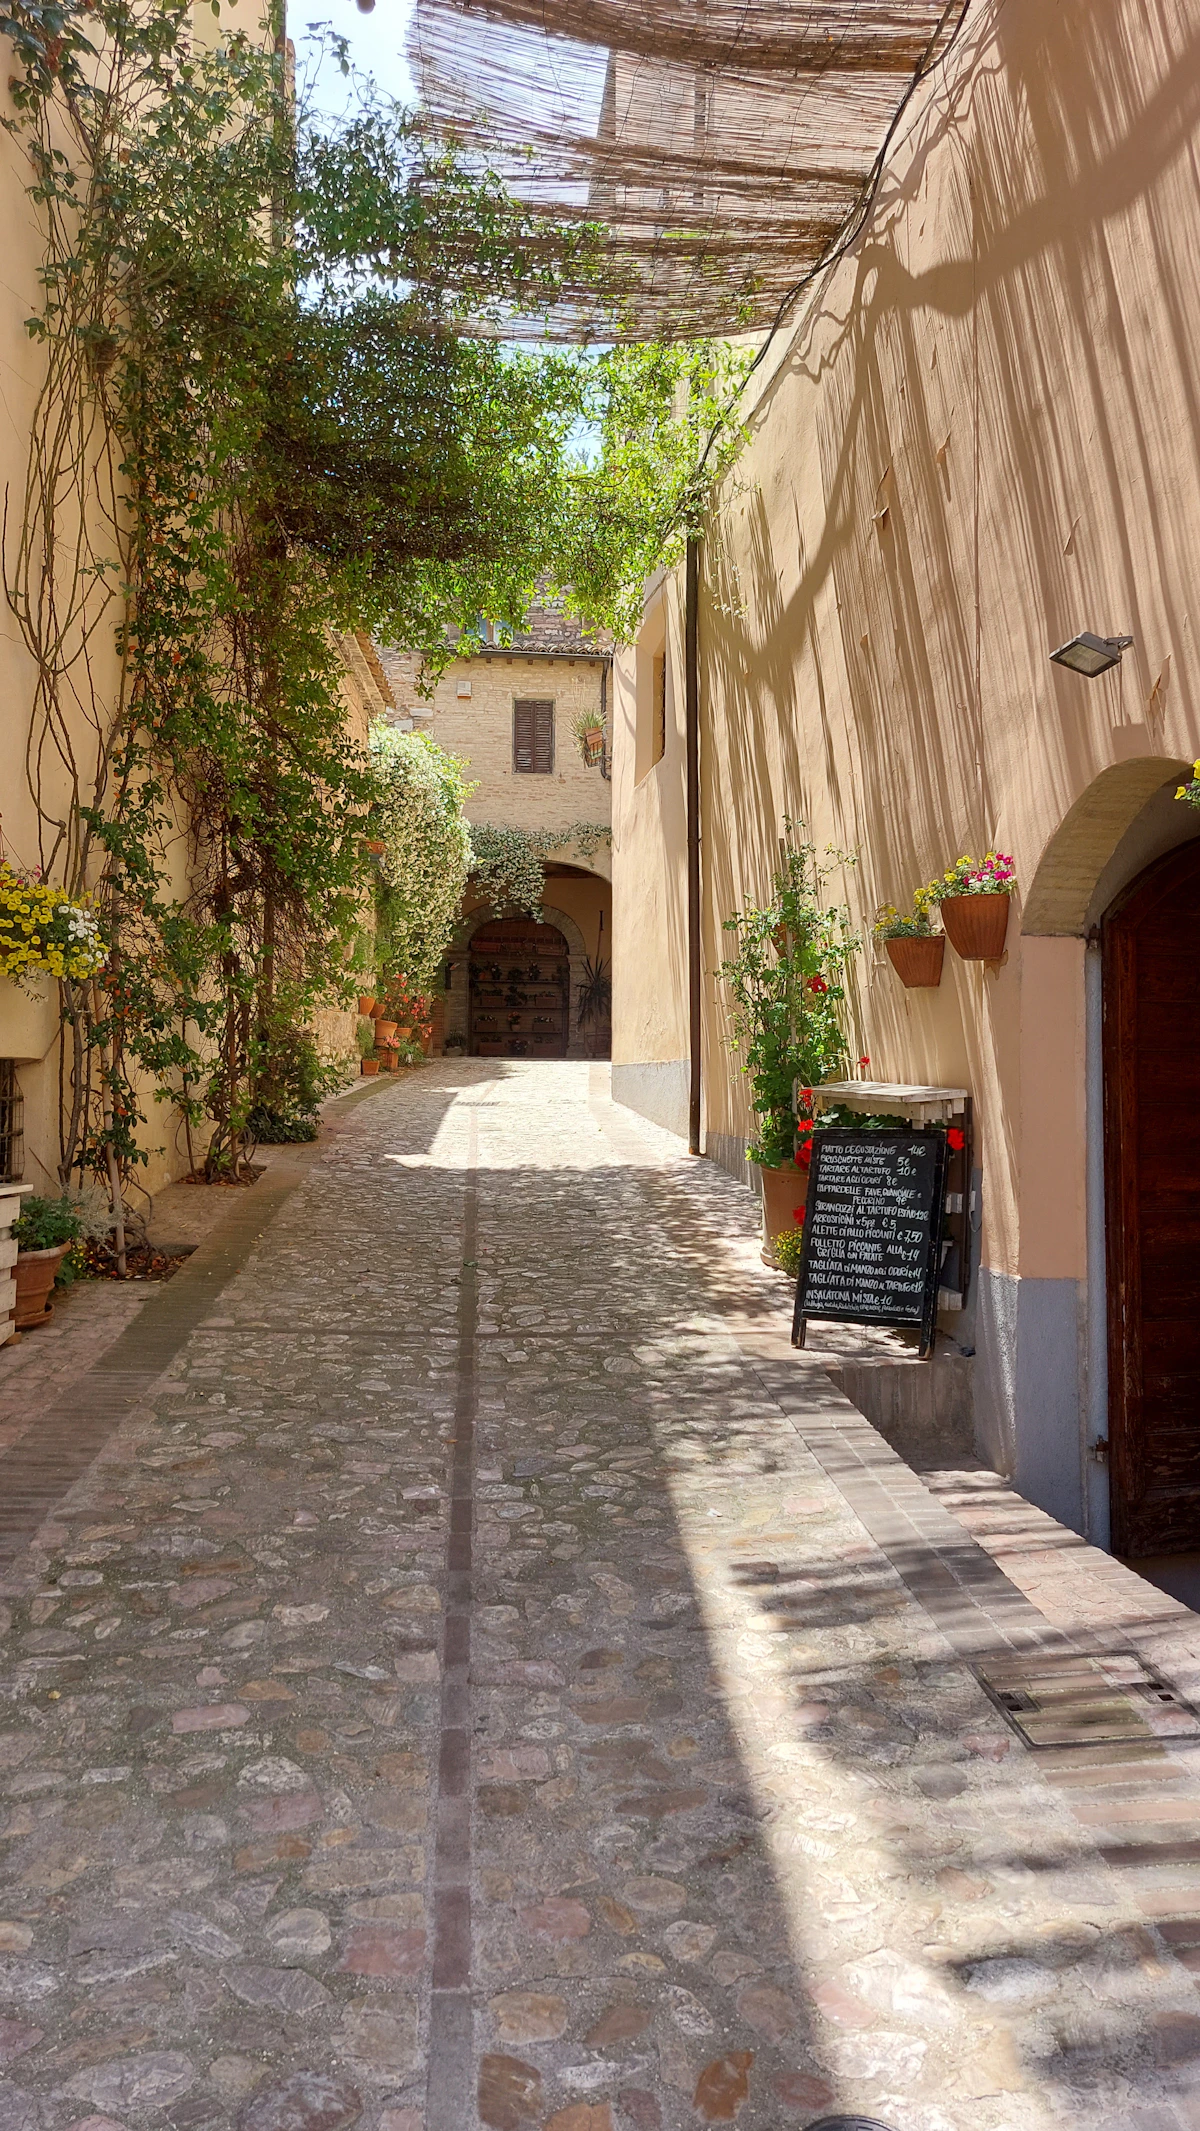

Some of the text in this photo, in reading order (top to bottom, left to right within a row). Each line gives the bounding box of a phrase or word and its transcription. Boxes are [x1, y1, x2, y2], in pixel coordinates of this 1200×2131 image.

[821, 1144, 844, 1154] PIATTO
[844, 1142, 897, 1155] DEGUSTAZIONE
[820, 1154, 864, 1164] BRUSCHETTE
[864, 1154, 886, 1165] MISTE
[820, 1164, 850, 1173] TARTARE
[851, 1166, 859, 1174] AL
[859, 1166, 891, 1175] TARTUFO
[818, 1174, 845, 1184] TARTARE
[846, 1174, 861, 1184] AGLI
[816, 1184, 862, 1196] PAPPARDELLE
[852, 1196, 886, 1205] PECORINO
[815, 1200, 855, 1214] STRANGOZZI
[856, 1206, 866, 1214] AL
[866, 1206, 897, 1216] TARTUFO
[812, 1214, 854, 1226] ARROSTICINI
[811, 1224, 838, 1236] ALETTE
[840, 1226, 846, 1236] DI
[846, 1228, 864, 1238] POLLO
[864, 1228, 896, 1240] PICCANTI
[848, 1240, 882, 1252] PICCANTE
[886, 1244, 902, 1254] ALLA
[817, 1248, 845, 1258] GRIGLIA
[859, 1251, 884, 1261] PATATE
[808, 1258, 843, 1272] TAGLIATA
[844, 1262, 850, 1272] DI
[850, 1264, 874, 1274] MANZO
[874, 1267, 886, 1276] AGLI
[888, 1265, 909, 1276] ODORI
[808, 1272, 846, 1287] TAGLIATA
[846, 1276, 855, 1286] DI
[855, 1278, 878, 1288] MANZO
[880, 1282, 885, 1290] AL
[886, 1280, 910, 1292] TARTUFO
[806, 1290, 850, 1302] INSALATONA
[852, 1290, 874, 1304] MISTA
